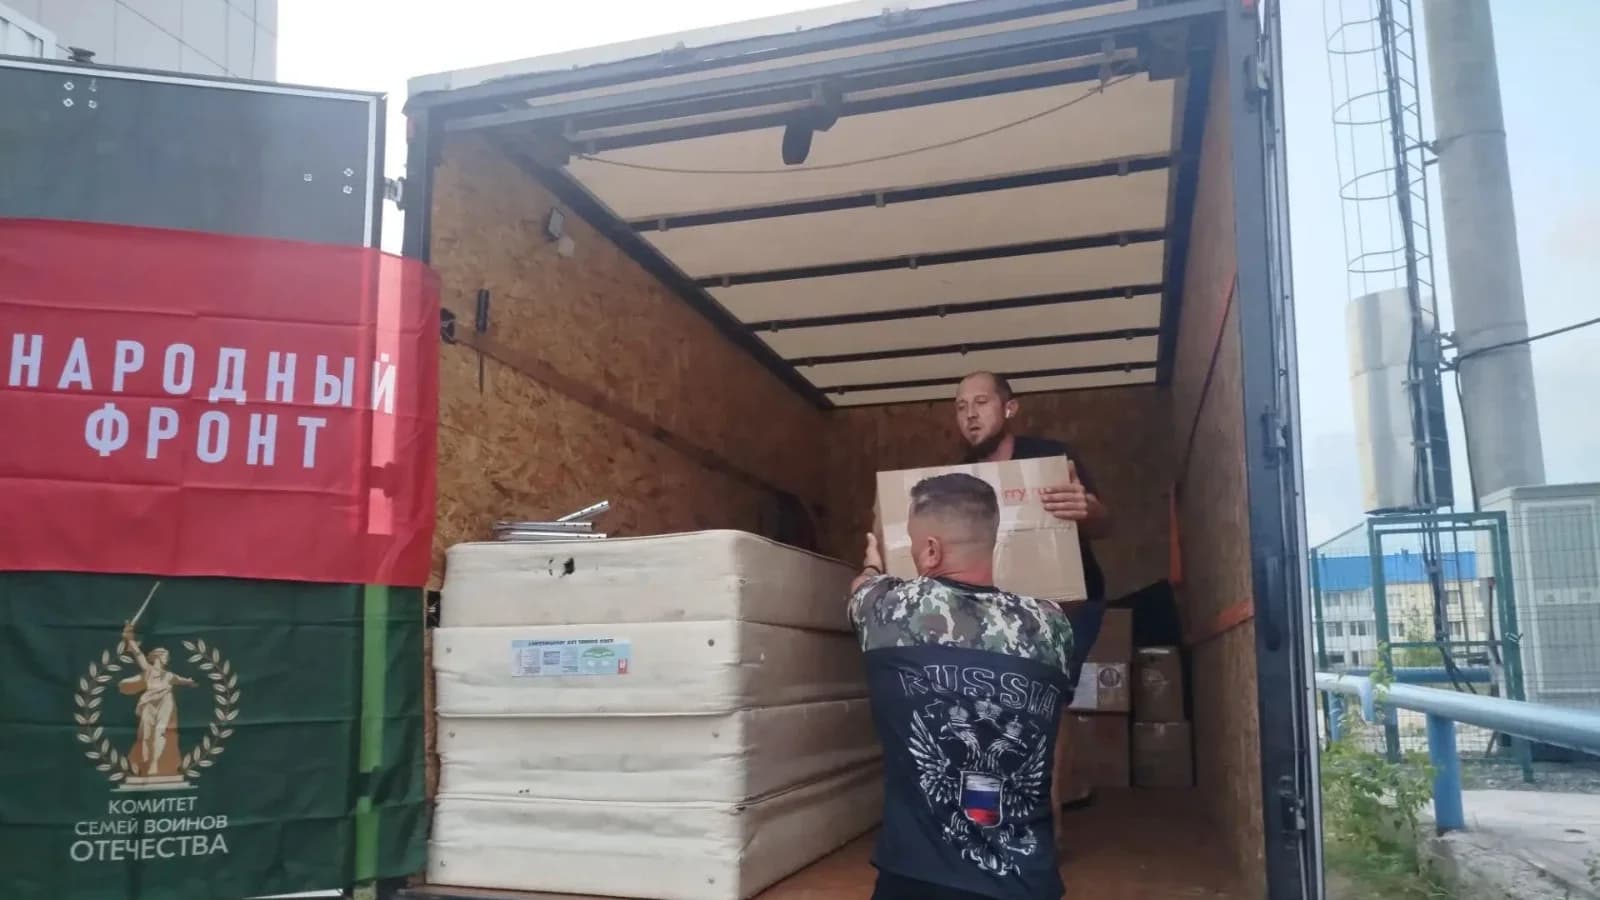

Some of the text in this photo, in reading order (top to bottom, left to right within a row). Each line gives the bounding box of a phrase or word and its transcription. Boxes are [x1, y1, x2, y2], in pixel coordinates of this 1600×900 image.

[8, 333, 397, 415] НАРОДНЫЙ
[84, 402, 327, 468] ФРОНТ
[108, 796, 198, 814] КОМИТЕТ
[74, 815, 228, 835] СЕМЕЙ ВОИНОВ
[69, 833, 229, 862] ОТЕЧЕСТВА
